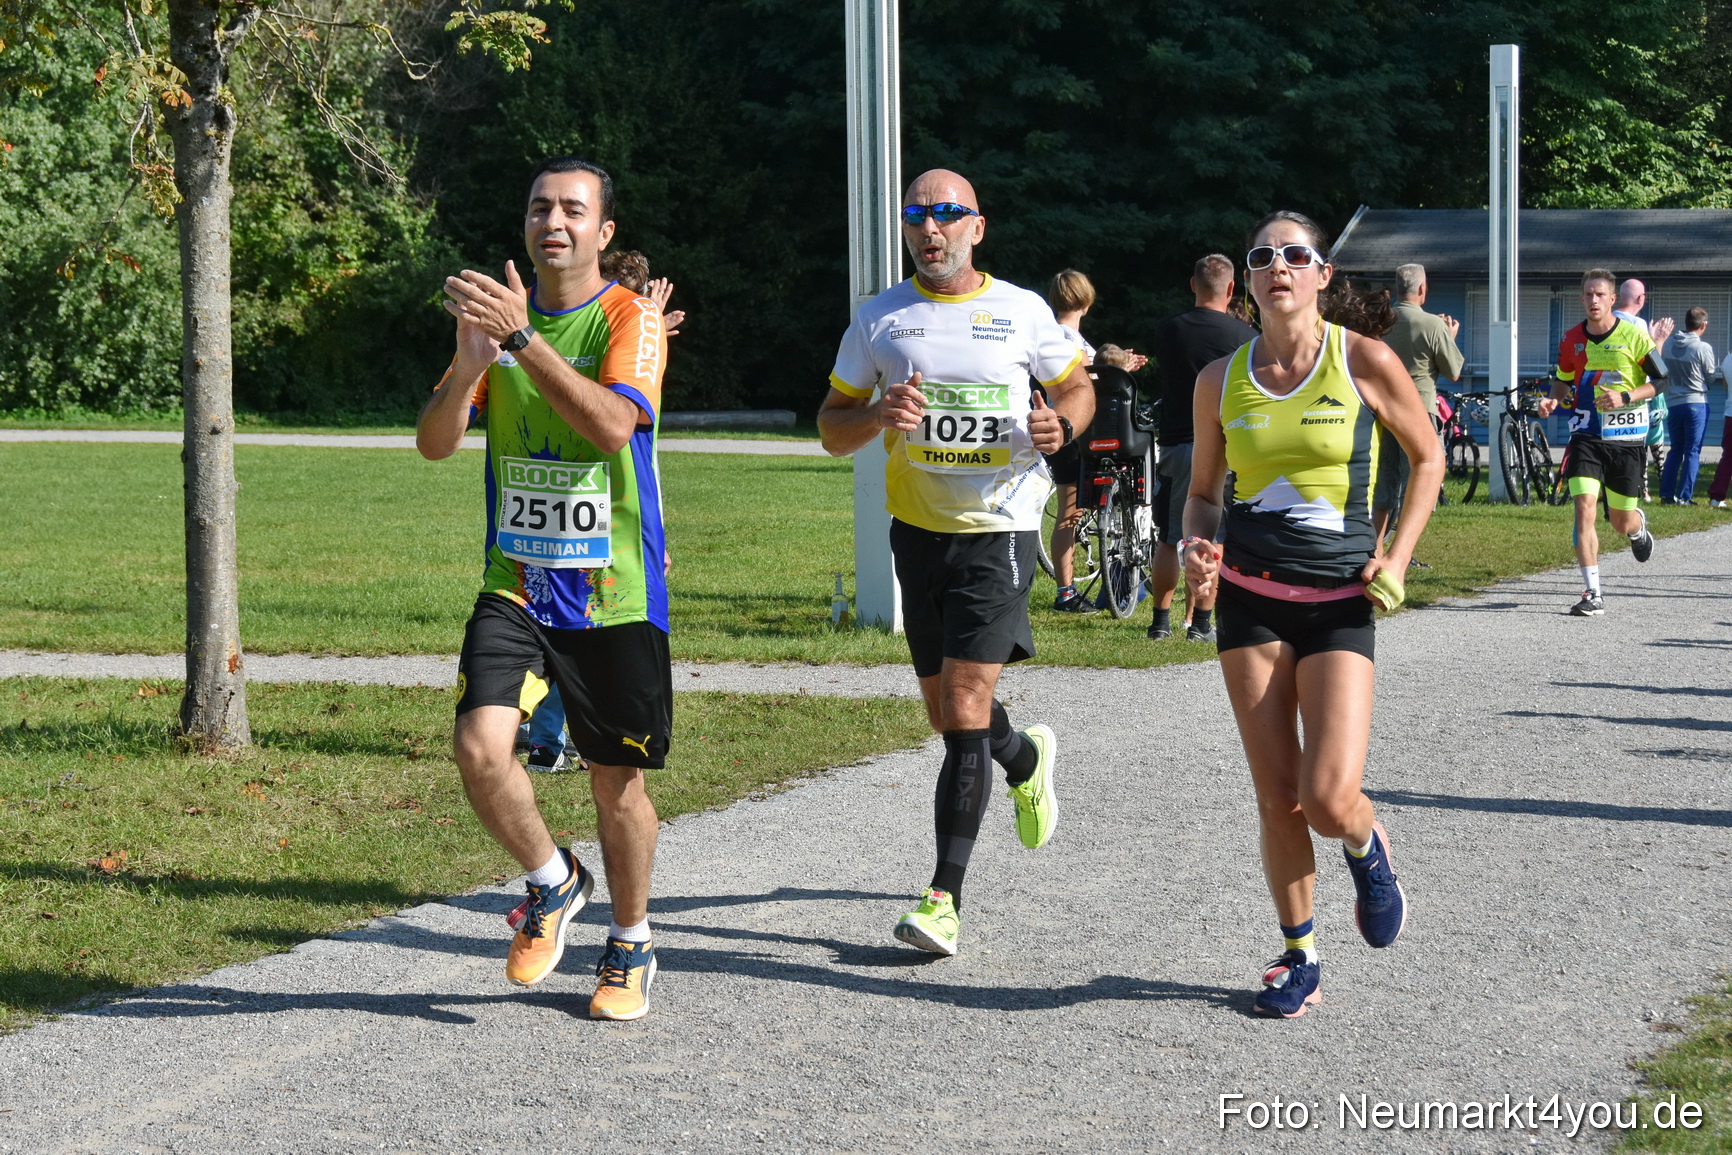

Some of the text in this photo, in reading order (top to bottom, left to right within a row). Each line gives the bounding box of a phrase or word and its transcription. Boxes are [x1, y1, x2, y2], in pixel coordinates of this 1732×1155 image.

[972, 313, 991, 324] 20
[890, 328, 925, 338] BOCK
[972, 325, 1016, 335] Neumarkter
[632, 297, 660, 387] BOCK
[972, 333, 1007, 343] Stadtlauf
[1303, 409, 1347, 417] Kettenbach
[1608, 412, 1643, 426] 2681
[1244, 422, 1270, 430] MARX
[1300, 417, 1345, 426] Runners
[922, 415, 999, 443] 1023
[923, 451, 991, 464] THOMAS
[507, 462, 599, 492] BOCK
[1006, 472, 1028, 502] September
[1026, 462, 1039, 476] 2019
[510, 496, 596, 532] 2510
[513, 539, 589, 556] SLEIMAN
[1010, 560, 1020, 585] BORG
